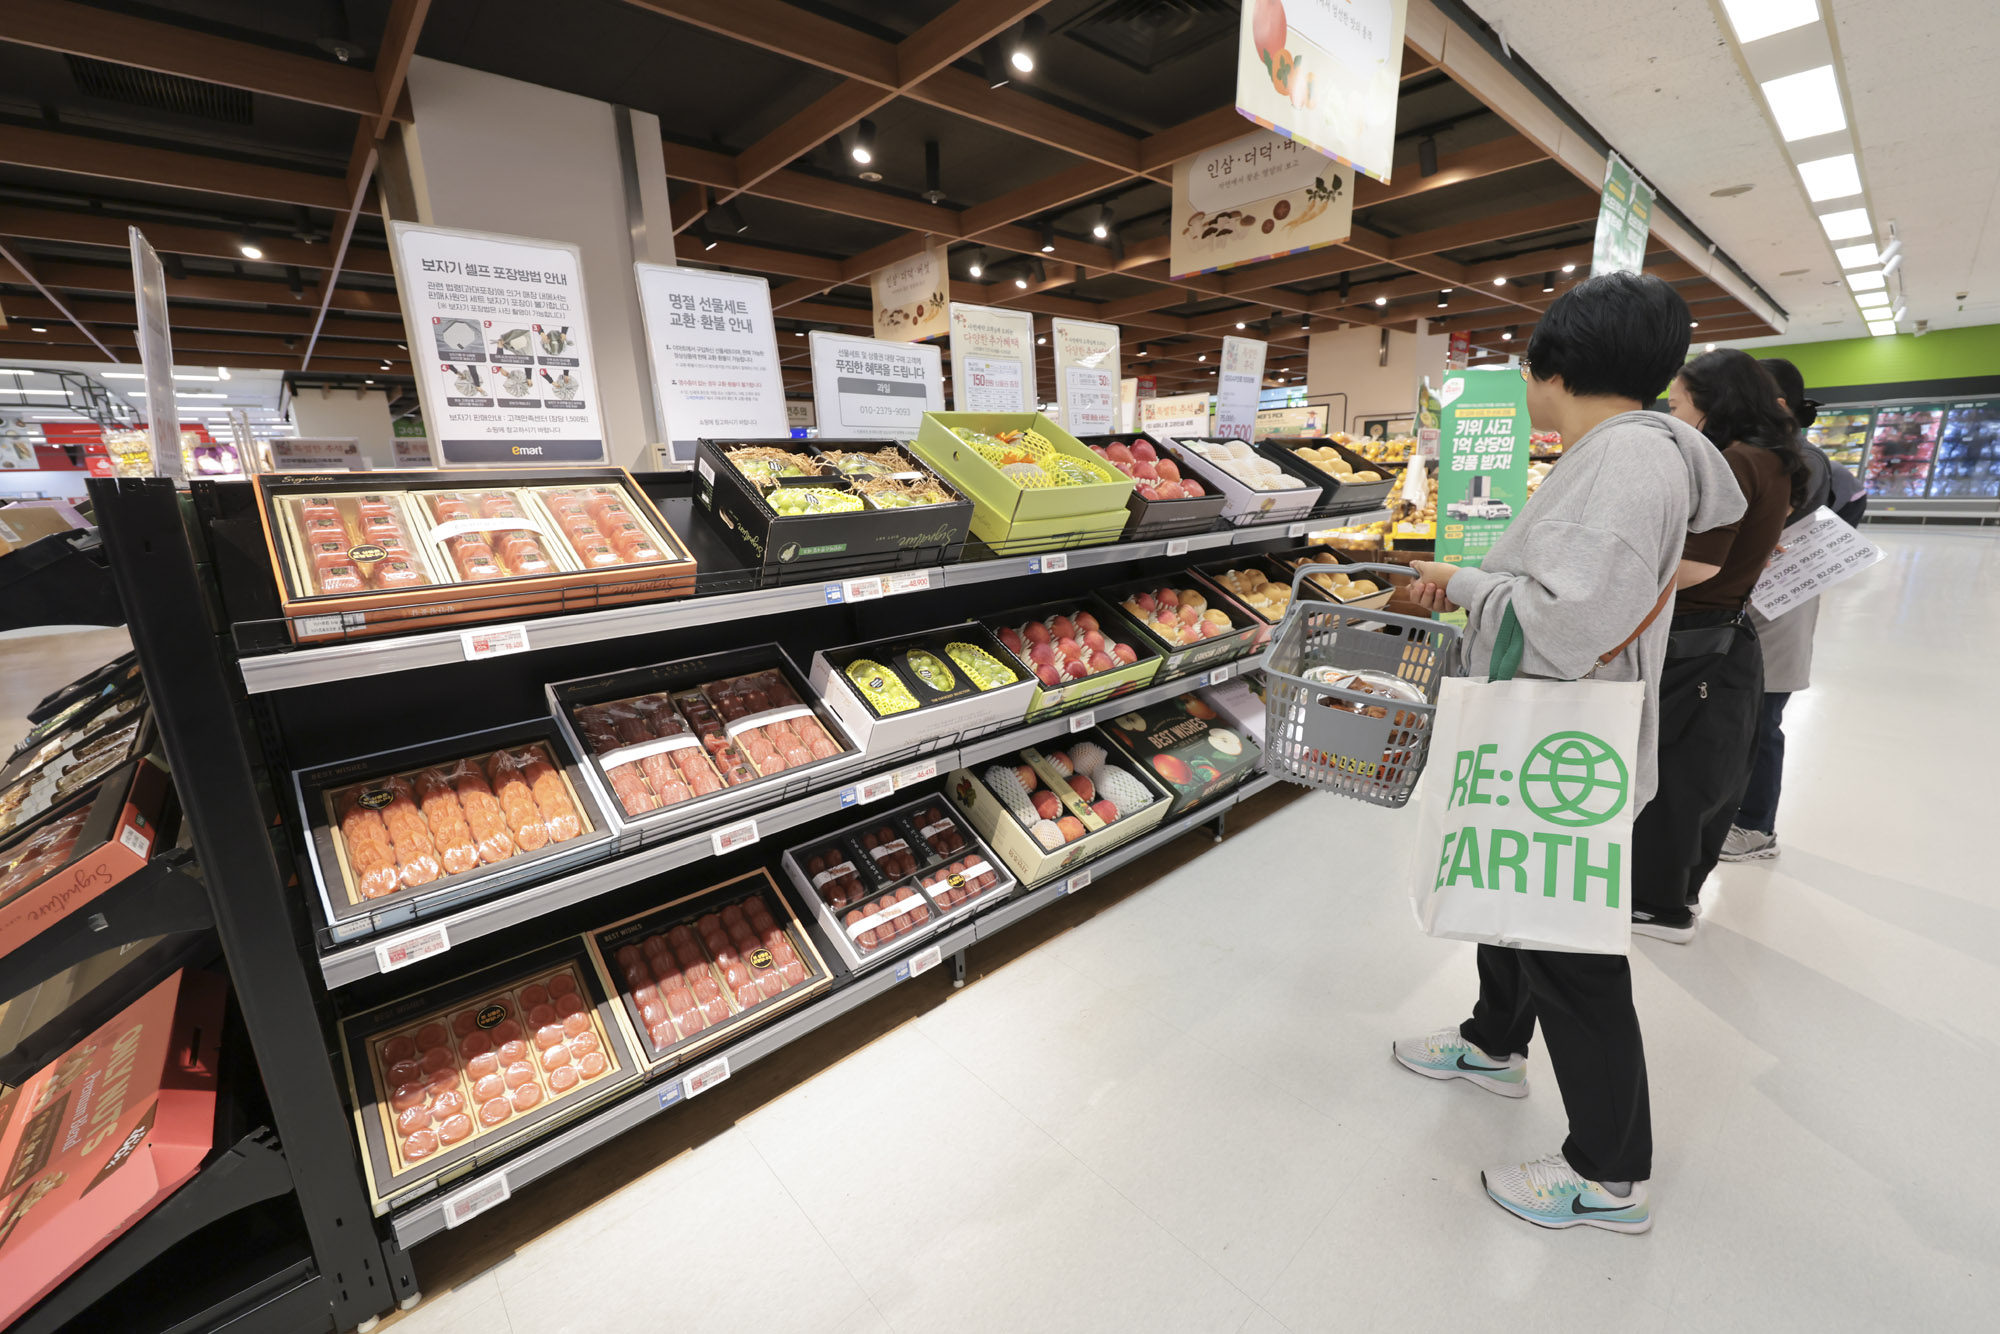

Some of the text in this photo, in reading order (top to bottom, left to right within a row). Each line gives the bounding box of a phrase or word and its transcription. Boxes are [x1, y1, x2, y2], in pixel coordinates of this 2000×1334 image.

[1207, 138, 1306, 179] 인삼·더덕·버
[421, 258, 568, 286] 보자기 셀프 포장방법 안내
[427, 281, 444, 291] 관련
[506, 289, 521, 298] 의거
[522, 291, 538, 300] 매장
[540, 292, 568, 302] 내에서는
[427, 291, 468, 302] 판매사원의
[470, 295, 486, 304] 세트
[487, 296, 510, 306] 보자기
[511, 298, 533, 308] 포장이
[449, 303, 470, 311] 보자기
[471, 305, 497, 313] 포장법은
[498, 307, 511, 315] 사진
[512, 308, 532, 317] 촬영이
[668, 293, 749, 315] 명절 선물세트
[670, 312, 754, 334] 교환·환불 안내
[838, 349, 861, 358] 선물세트
[868, 352, 884, 361] 상품권
[836, 359, 925, 379] 푸짐한 혜택을 드립니다
[876, 383, 891, 393] 과일
[449, 414, 471, 422] 보자기
[474, 414, 502, 422] 판매안내
[507, 414, 548, 422] 고객만족센터
[1455, 418, 1513, 435] 키위 사고
[512, 445, 543, 455] emart
[1452, 436, 1515, 453] 1억 상당의
[1451, 454, 1512, 471] 경품 받자!
[281, 475, 335, 484] Signature
[897, 523, 958, 549] Signature
[1799, 548, 1825, 564] 99,000
[1826, 532, 1852, 549] 99,000
[1764, 593, 1789, 609] 99,000
[1790, 578, 1815, 594] 99,000
[1147, 717, 1208, 749] BEST WISHES
[311, 762, 368, 781] BEST WISHES
[1448, 743, 1513, 811] RE:
[1434, 826, 1621, 909] EARTH
[27, 863, 113, 920] Signature
[604, 923, 643, 943] BEST WISHES
[81, 1024, 144, 1157] ONLY NUTS
[62, 1069, 102, 1152] Premium Blend
